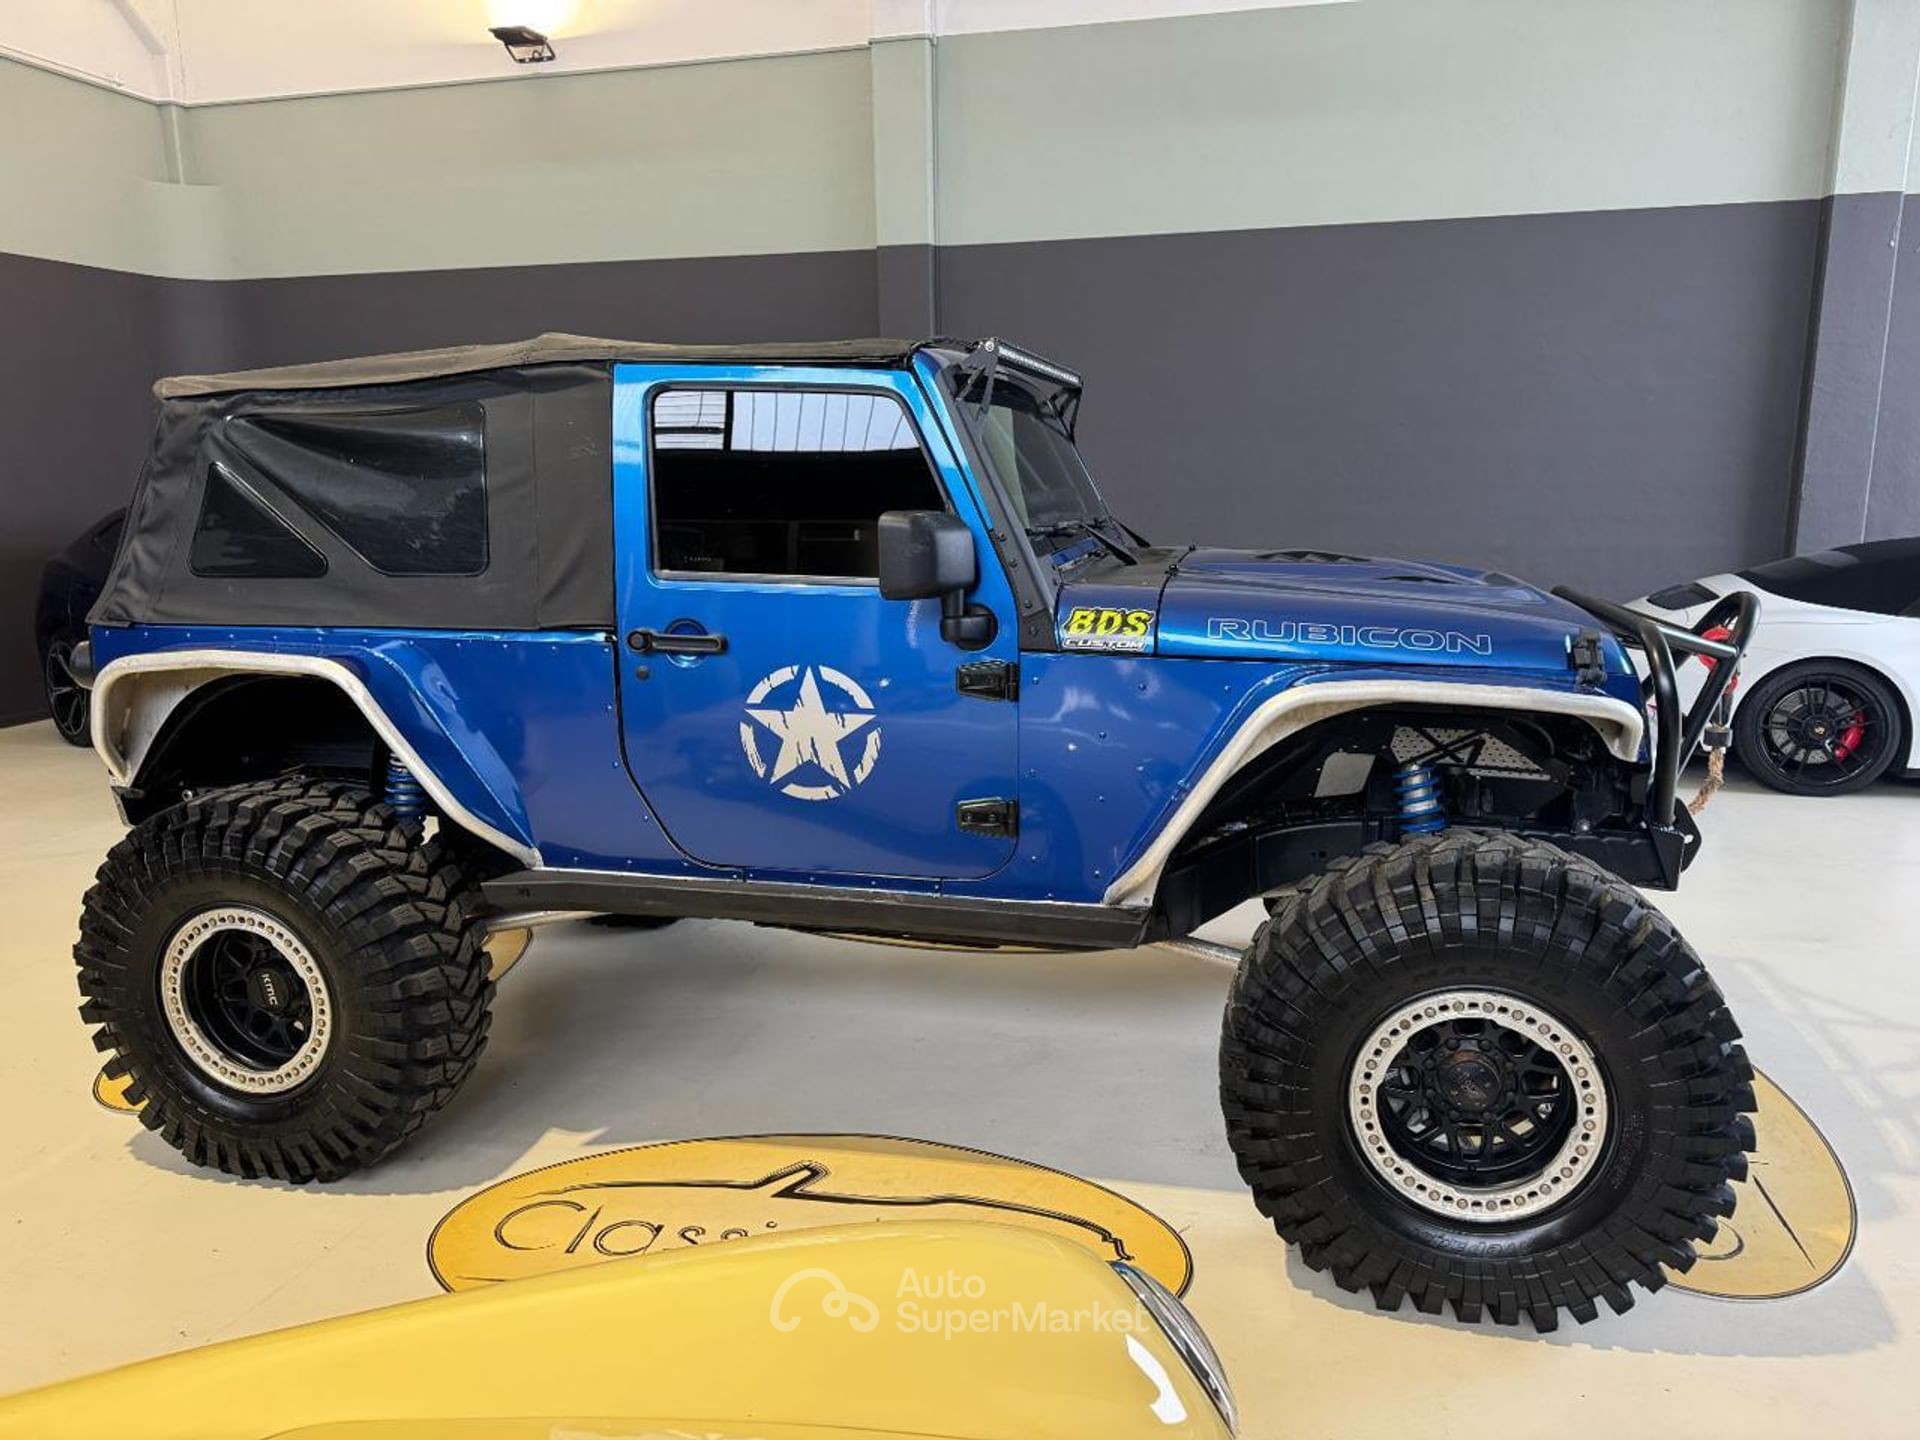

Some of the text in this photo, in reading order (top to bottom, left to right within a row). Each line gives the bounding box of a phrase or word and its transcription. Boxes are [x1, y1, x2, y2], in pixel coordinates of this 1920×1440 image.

[1067, 608, 1151, 637] BDS
[1207, 617, 1493, 656] RUBICON
[1064, 639, 1145, 651] CUSTOM
